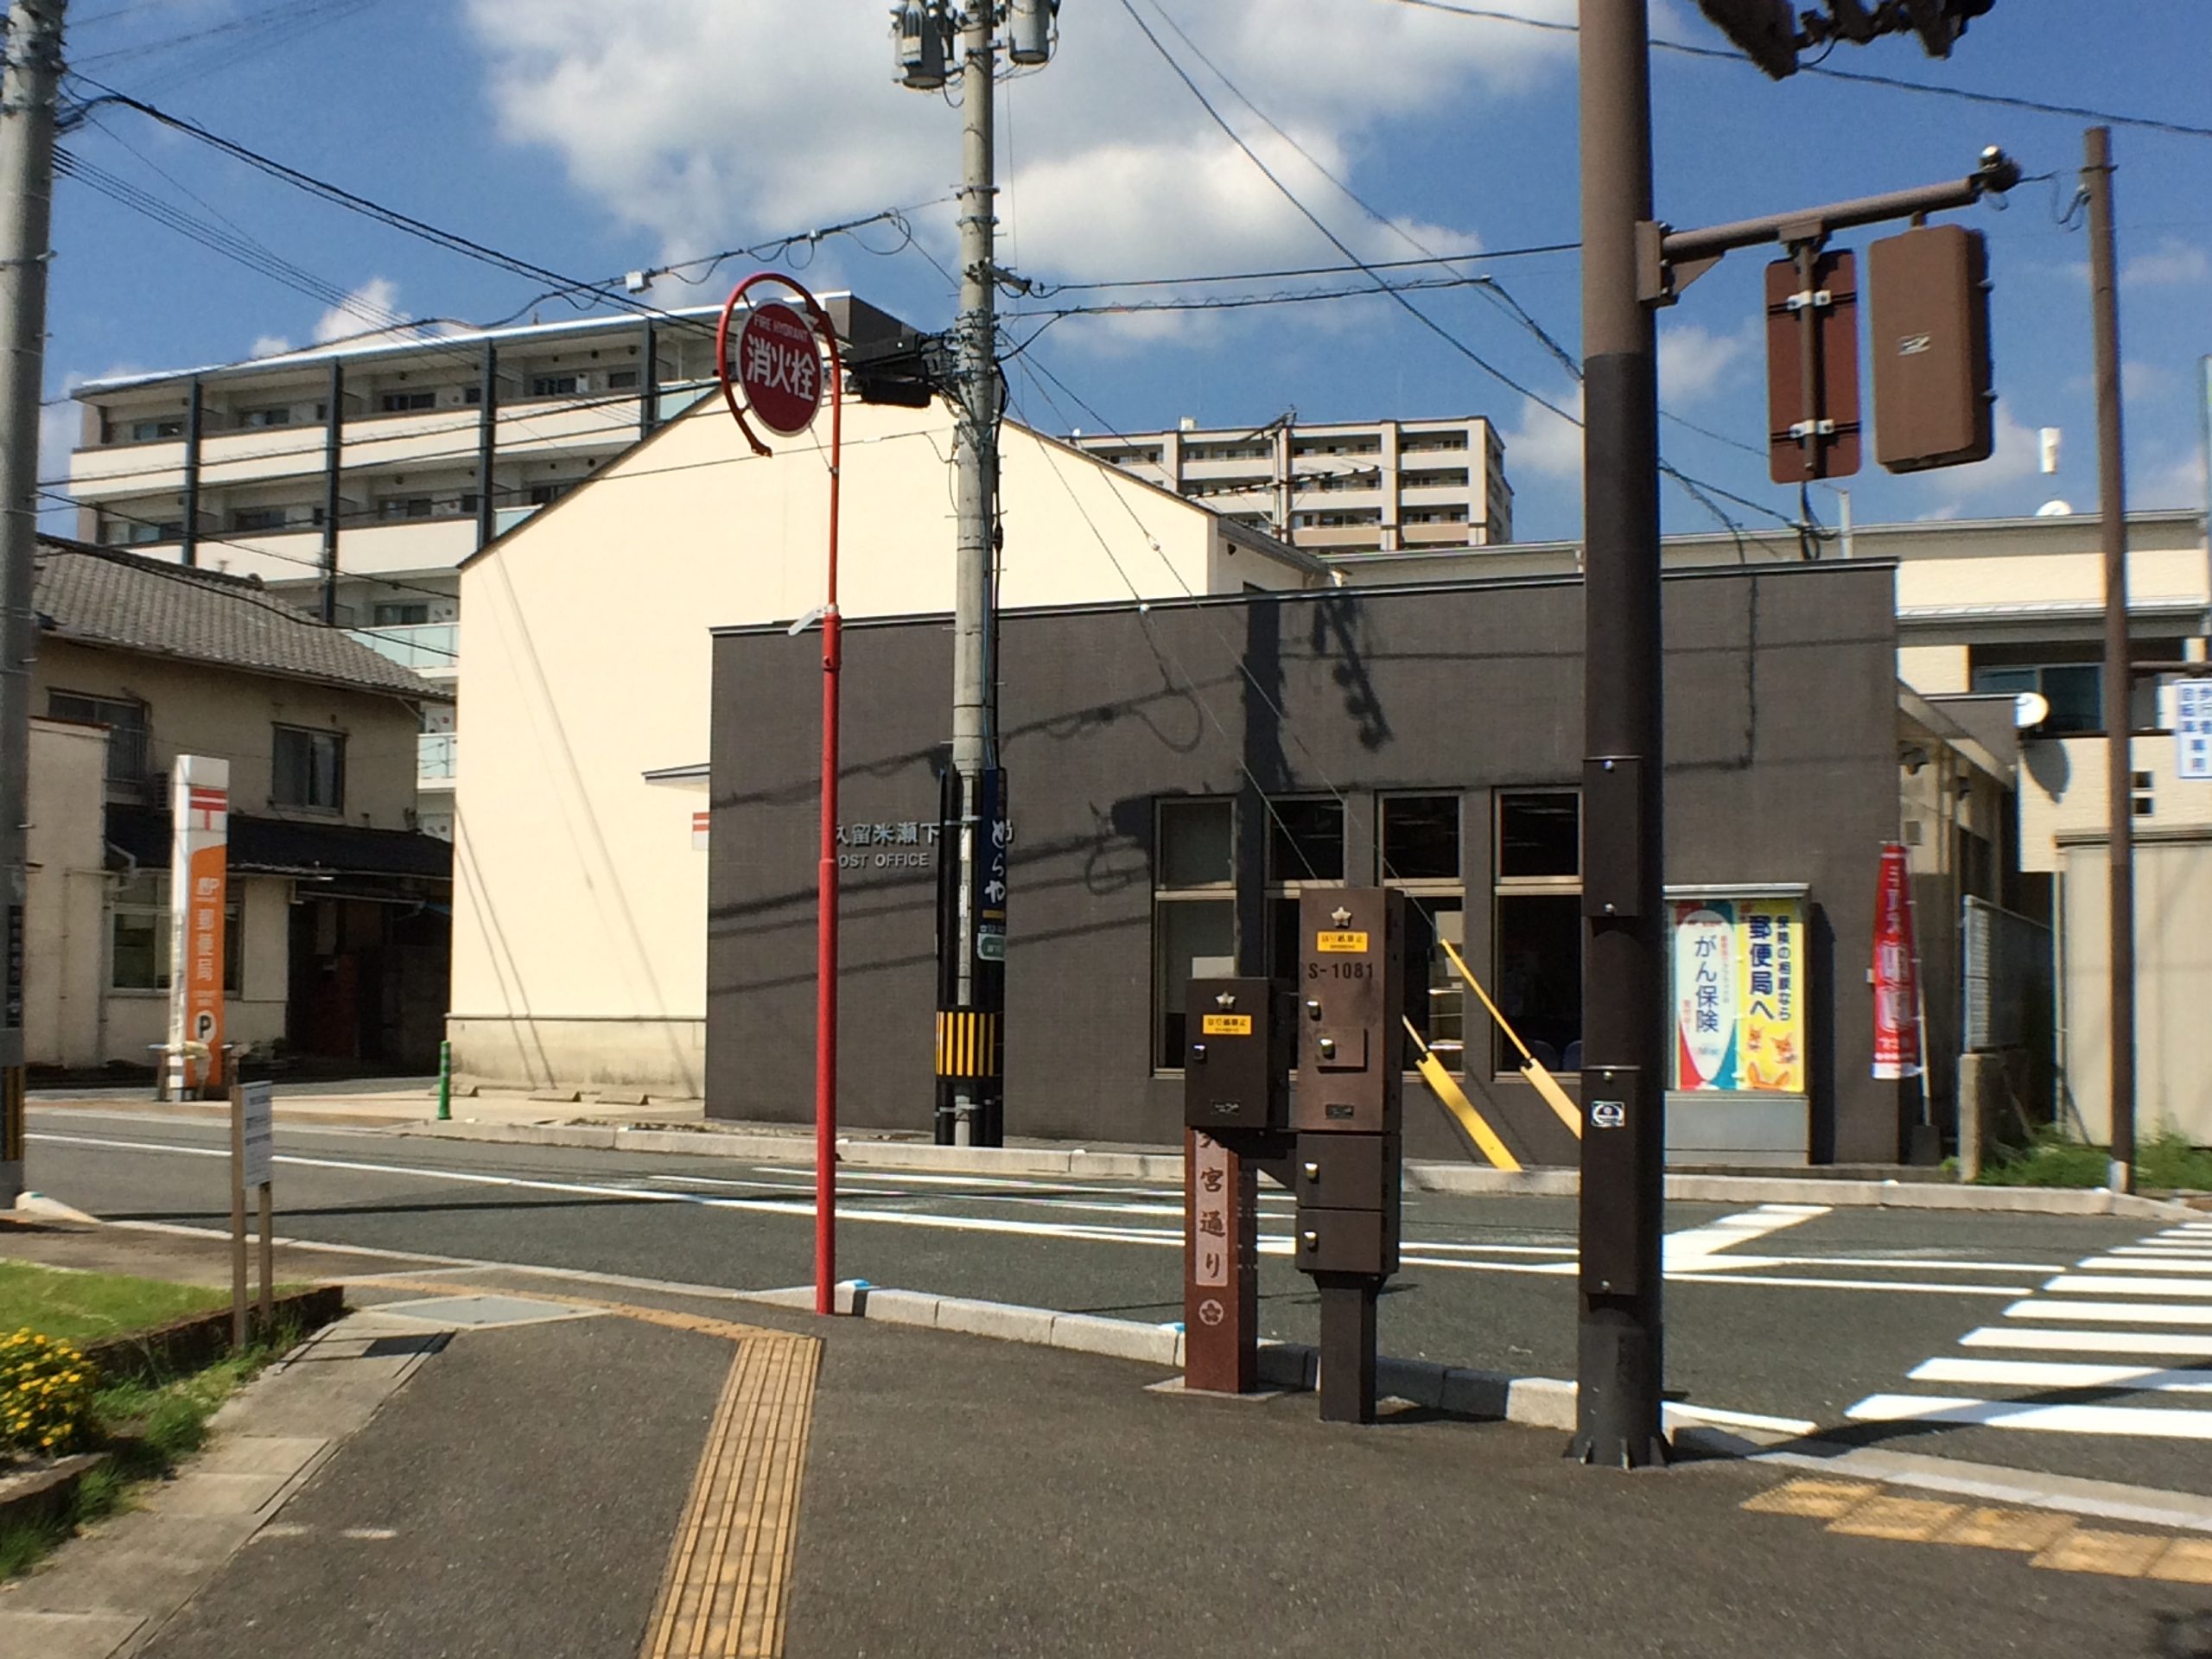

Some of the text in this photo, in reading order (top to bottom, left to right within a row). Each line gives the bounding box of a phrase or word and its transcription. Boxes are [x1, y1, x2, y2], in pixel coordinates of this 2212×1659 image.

[747, 334, 816, 402] 消火栓
[839, 852, 929, 868] OST OFFICE
[1308, 963, 1374, 979] S-1081
[1694, 935, 1719, 1033] がん保険
[1749, 915, 1774, 1020] 郵便局へ
[198, 1014, 212, 1039] P
